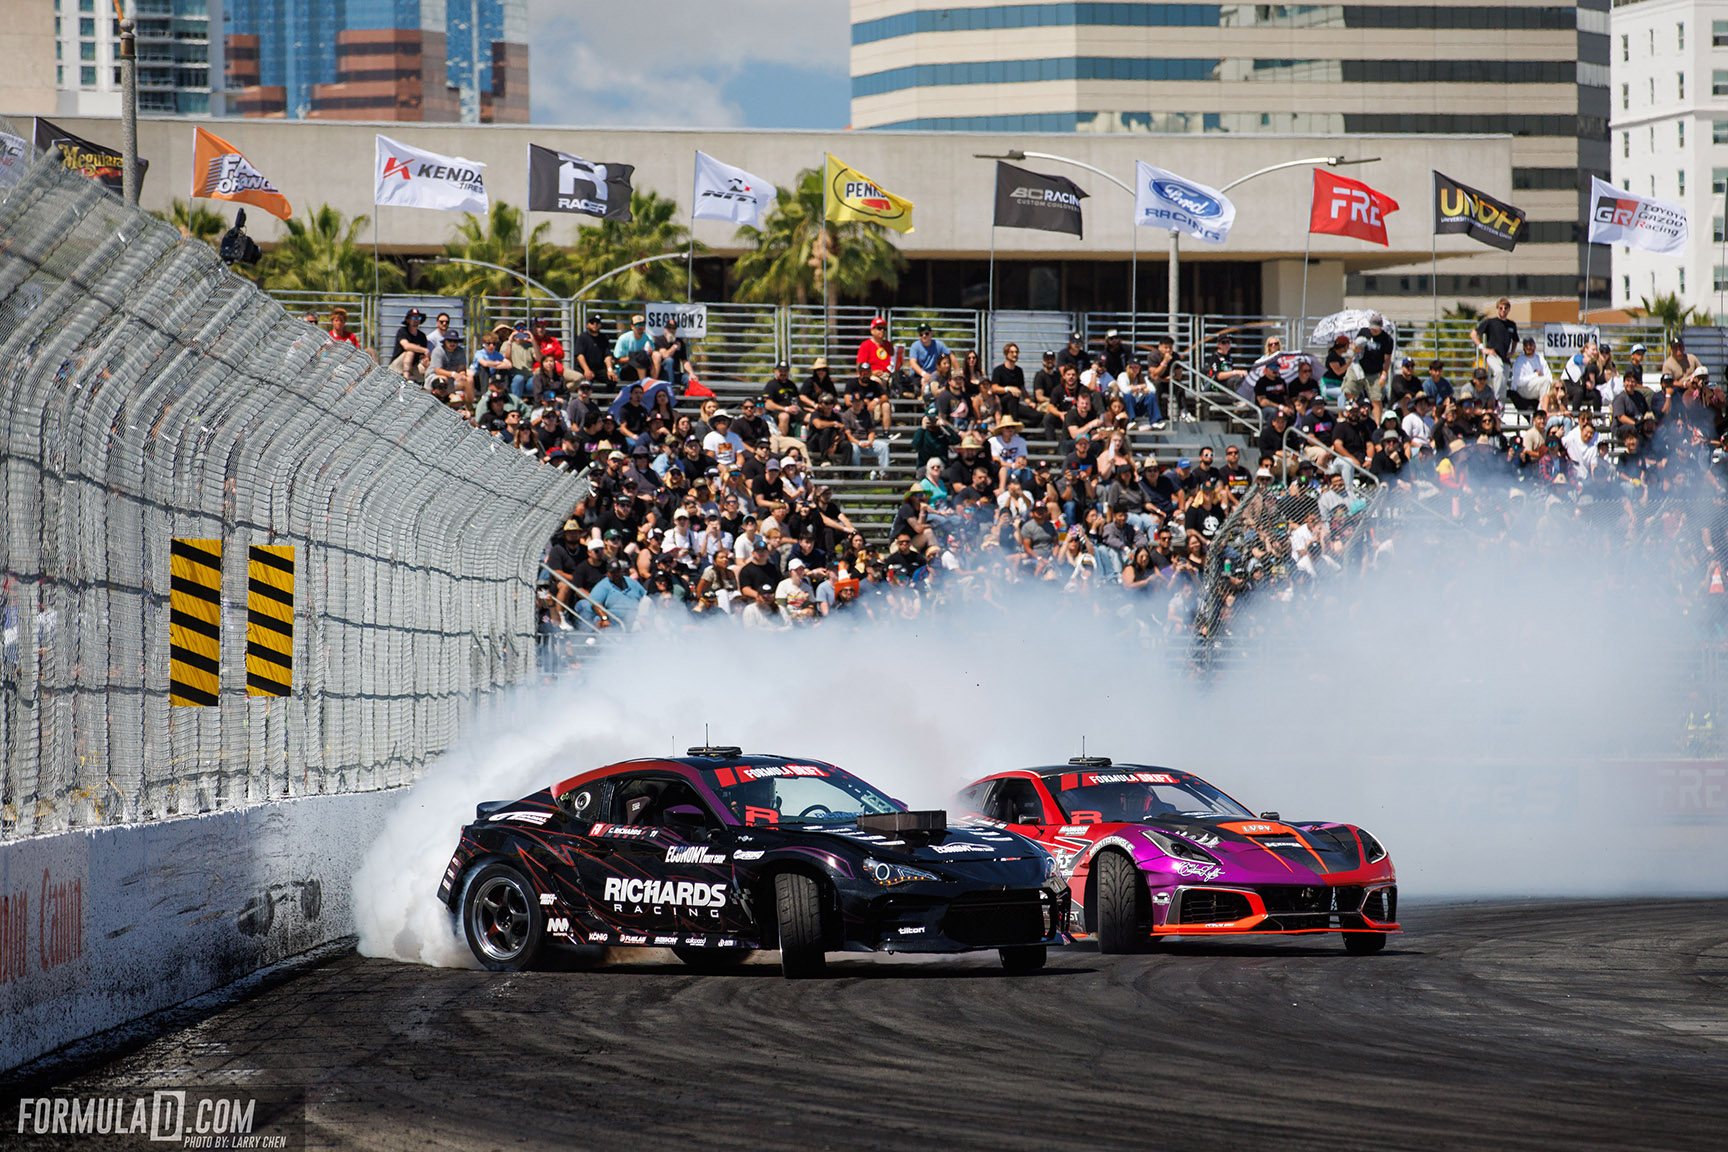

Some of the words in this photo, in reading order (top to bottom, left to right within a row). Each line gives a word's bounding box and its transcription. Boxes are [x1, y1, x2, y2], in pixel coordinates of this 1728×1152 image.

[418, 163, 484, 186] KENDA
[217, 176, 279, 194] ORANG
[460, 182, 484, 194] TIRES
[558, 197, 608, 215] RACER
[1016, 199, 1046, 207] CUSTOM
[1046, 201, 1080, 213] COILOVER
[1044, 189, 1081, 207] RACIN
[1162, 184, 1209, 214] Ford
[1441, 187, 1521, 236] UNOH
[1595, 206, 1633, 226] GR
[1638, 211, 1683, 228] GAZOO
[1641, 202, 1687, 222] TOYOTA
[1145, 207, 1221, 240] RACING
[1634, 219, 1679, 237] Racing
[648, 312, 695, 329] SECTION
[697, 313, 704, 329] 2
[1547, 333, 1590, 349] SECTION
[743, 766, 794, 779] FORMULA
[788, 765, 825, 777] DRIFT
[1089, 774, 1140, 784] FORMULA
[1137, 773, 1174, 784] DRIFT
[665, 846, 709, 864] ECONOMY
[613, 903, 720, 918] RACING
[898, 926, 926, 935] tilton
